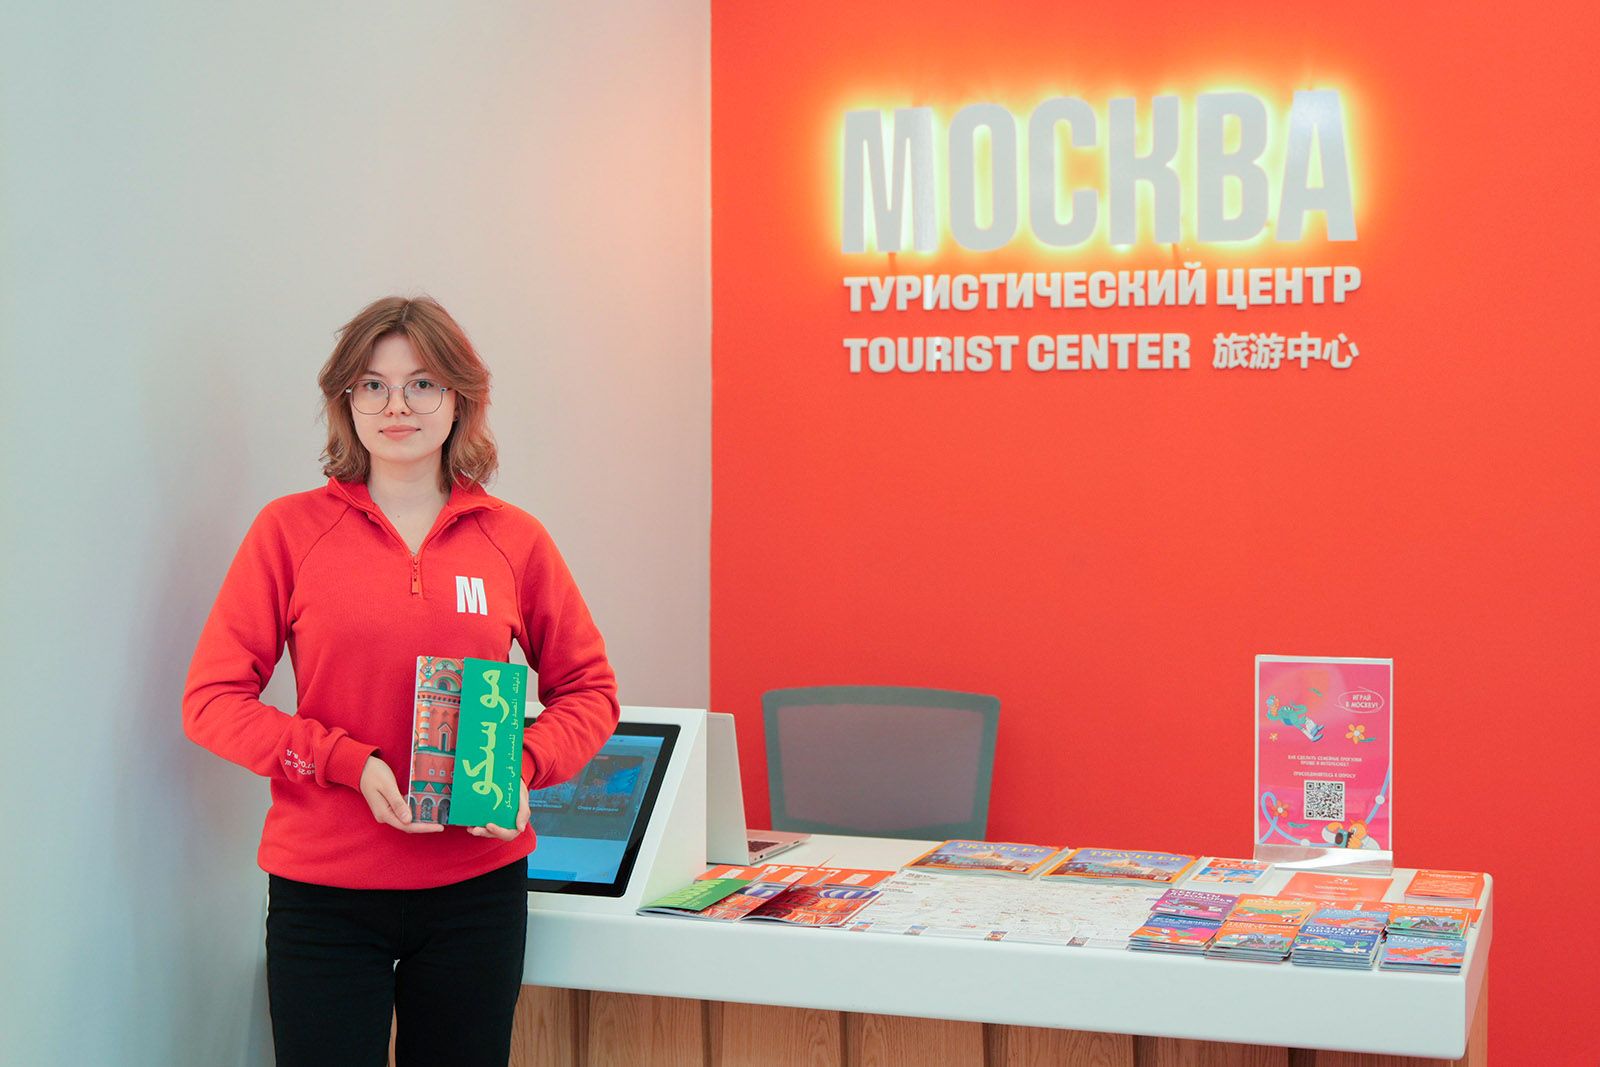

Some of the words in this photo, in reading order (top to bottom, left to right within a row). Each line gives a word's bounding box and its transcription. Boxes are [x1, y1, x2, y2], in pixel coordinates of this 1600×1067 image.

[841, 90, 1358, 254] МОСКВА
[843, 261, 1207, 312] ТУРИСТИЧЕСКИЙ
[1216, 266, 1361, 311] ЦЕНТР
[843, 336, 1019, 374] TOURIST
[1027, 333, 1190, 371] CENTER
[1212, 331, 1360, 371] 旅游中心
[956, 842, 1046, 854] TRAVELER
[1090, 850, 1182, 862] TRAVELER
